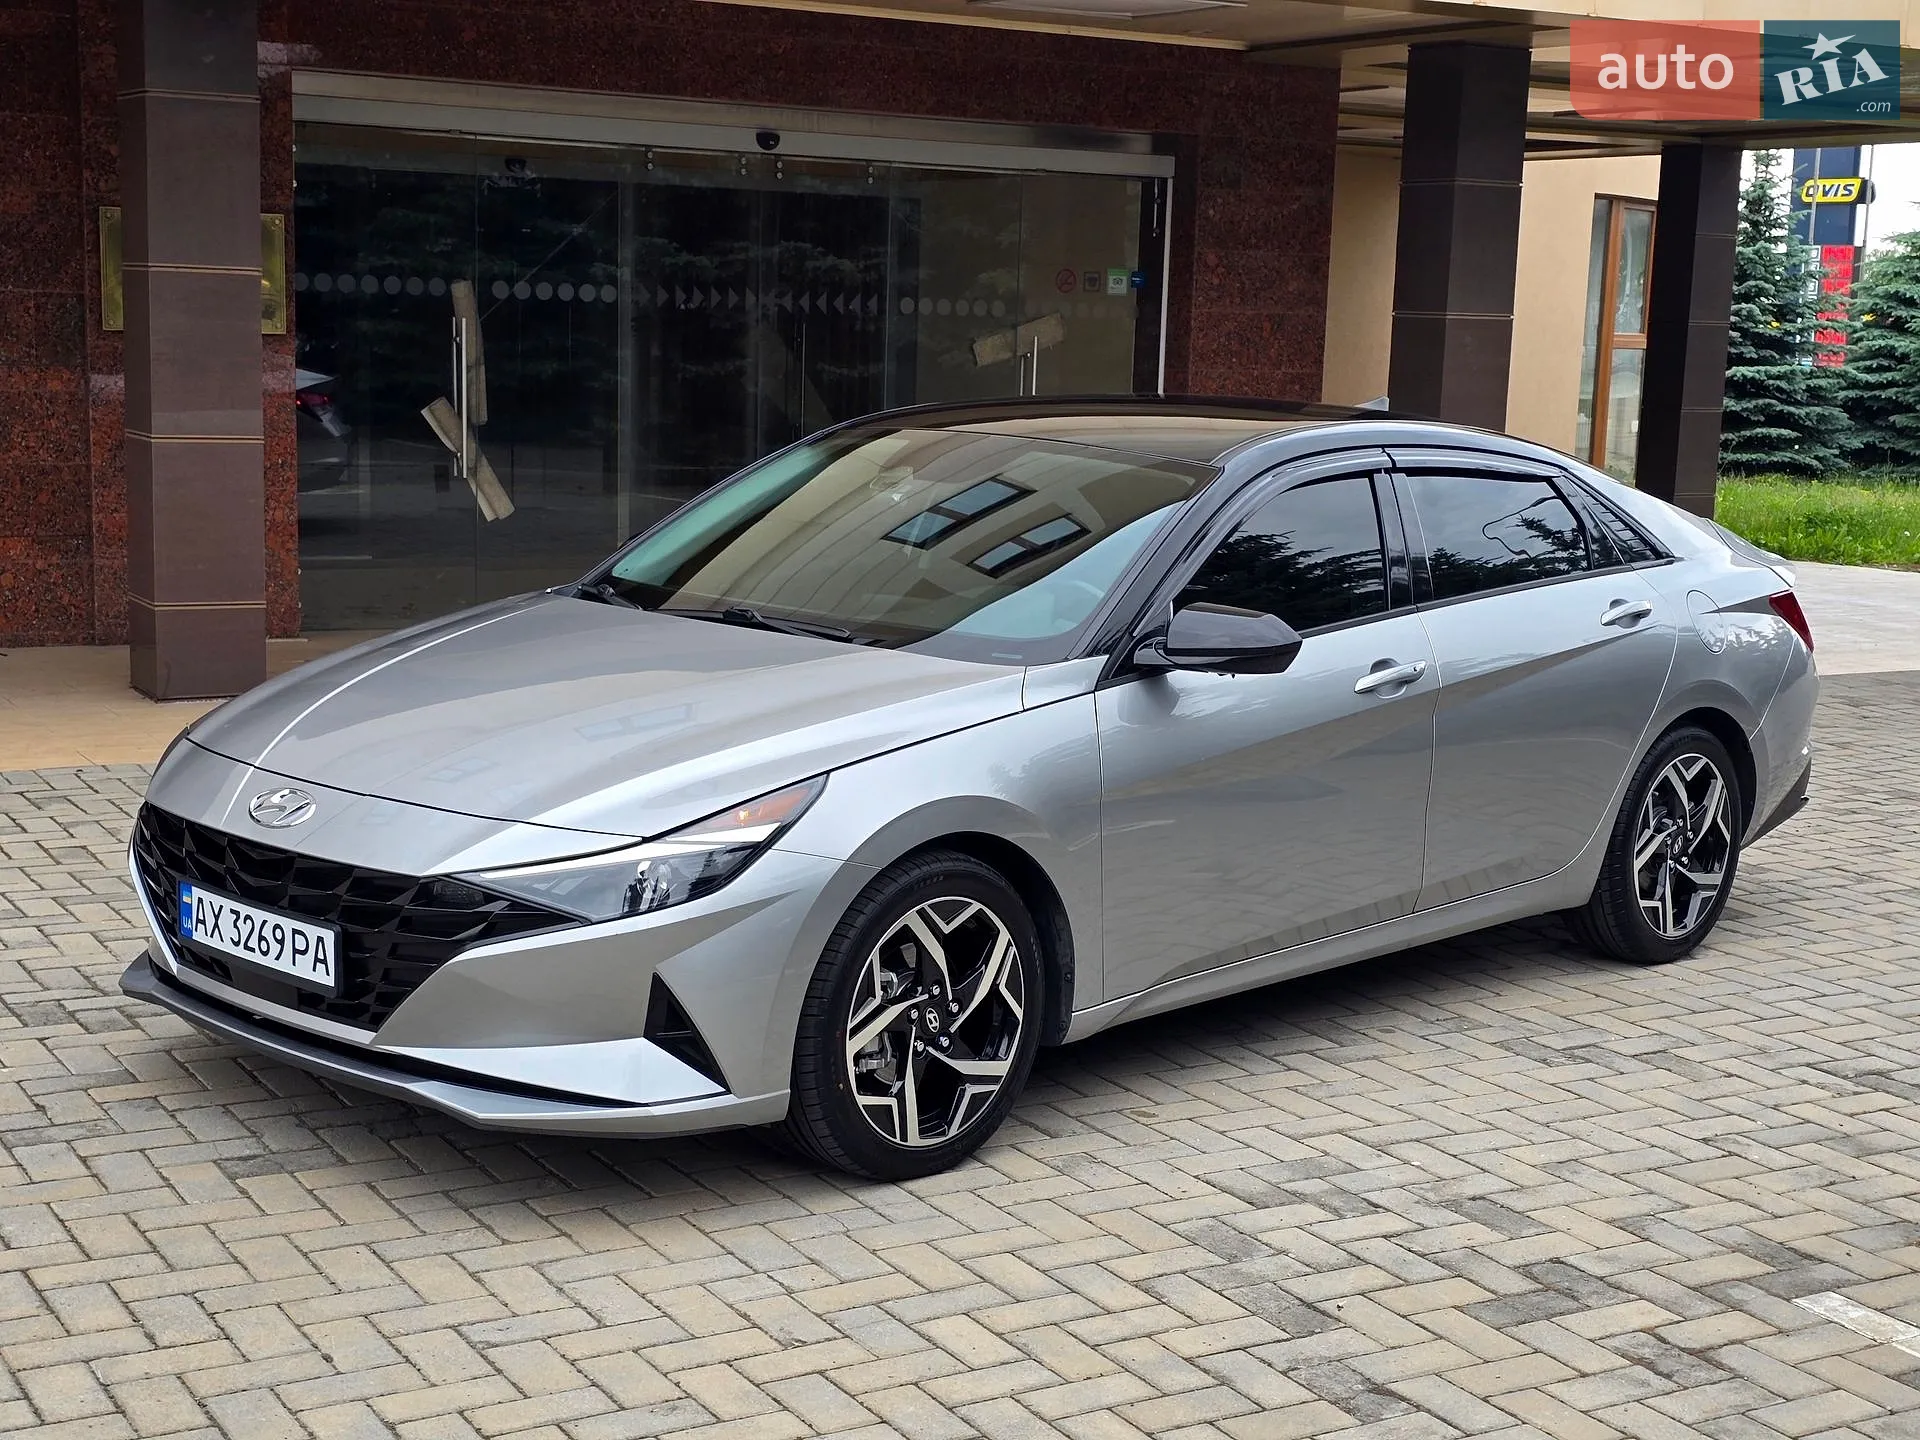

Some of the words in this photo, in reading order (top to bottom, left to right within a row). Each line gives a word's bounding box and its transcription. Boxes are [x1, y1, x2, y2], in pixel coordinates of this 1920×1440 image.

[1805, 183, 1855, 198] OVIS
[182, 917, 193, 930] UA
[194, 896, 224, 942] AX
[230, 908, 286, 961] 3269
[291, 927, 330, 977] PA
